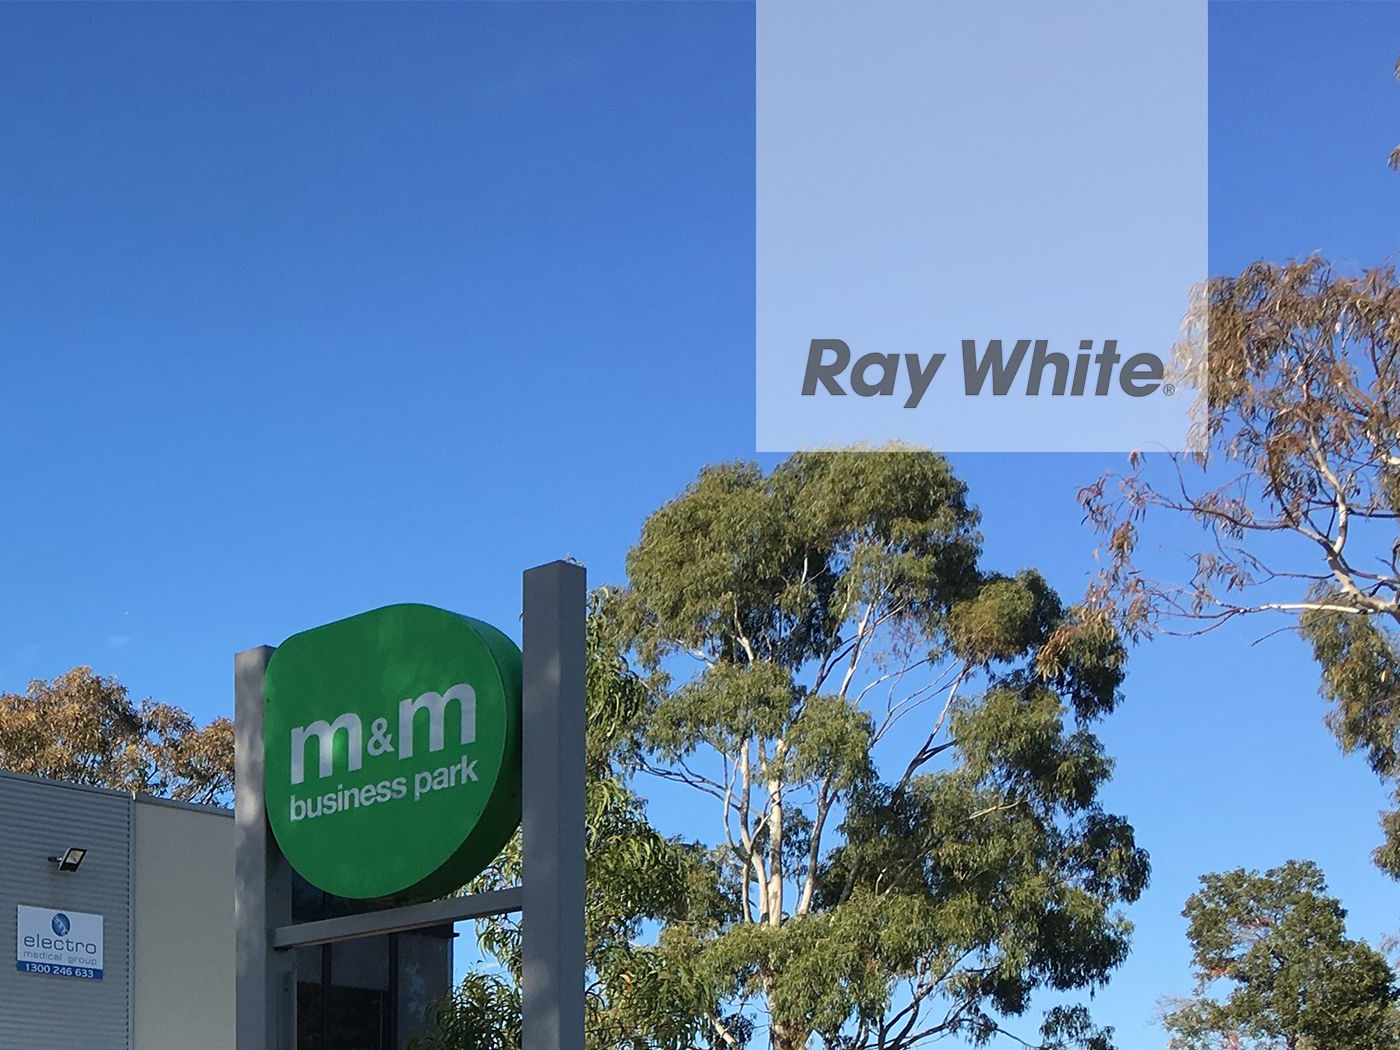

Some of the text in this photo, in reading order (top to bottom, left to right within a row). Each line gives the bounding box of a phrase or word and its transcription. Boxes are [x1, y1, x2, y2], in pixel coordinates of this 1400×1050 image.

[290, 683, 477, 786] m&m
[289, 754, 479, 823] business park
[23, 933, 97, 955] electro
[23, 951, 98, 966] medical group
[25, 963, 94, 978] 1300 246 633
